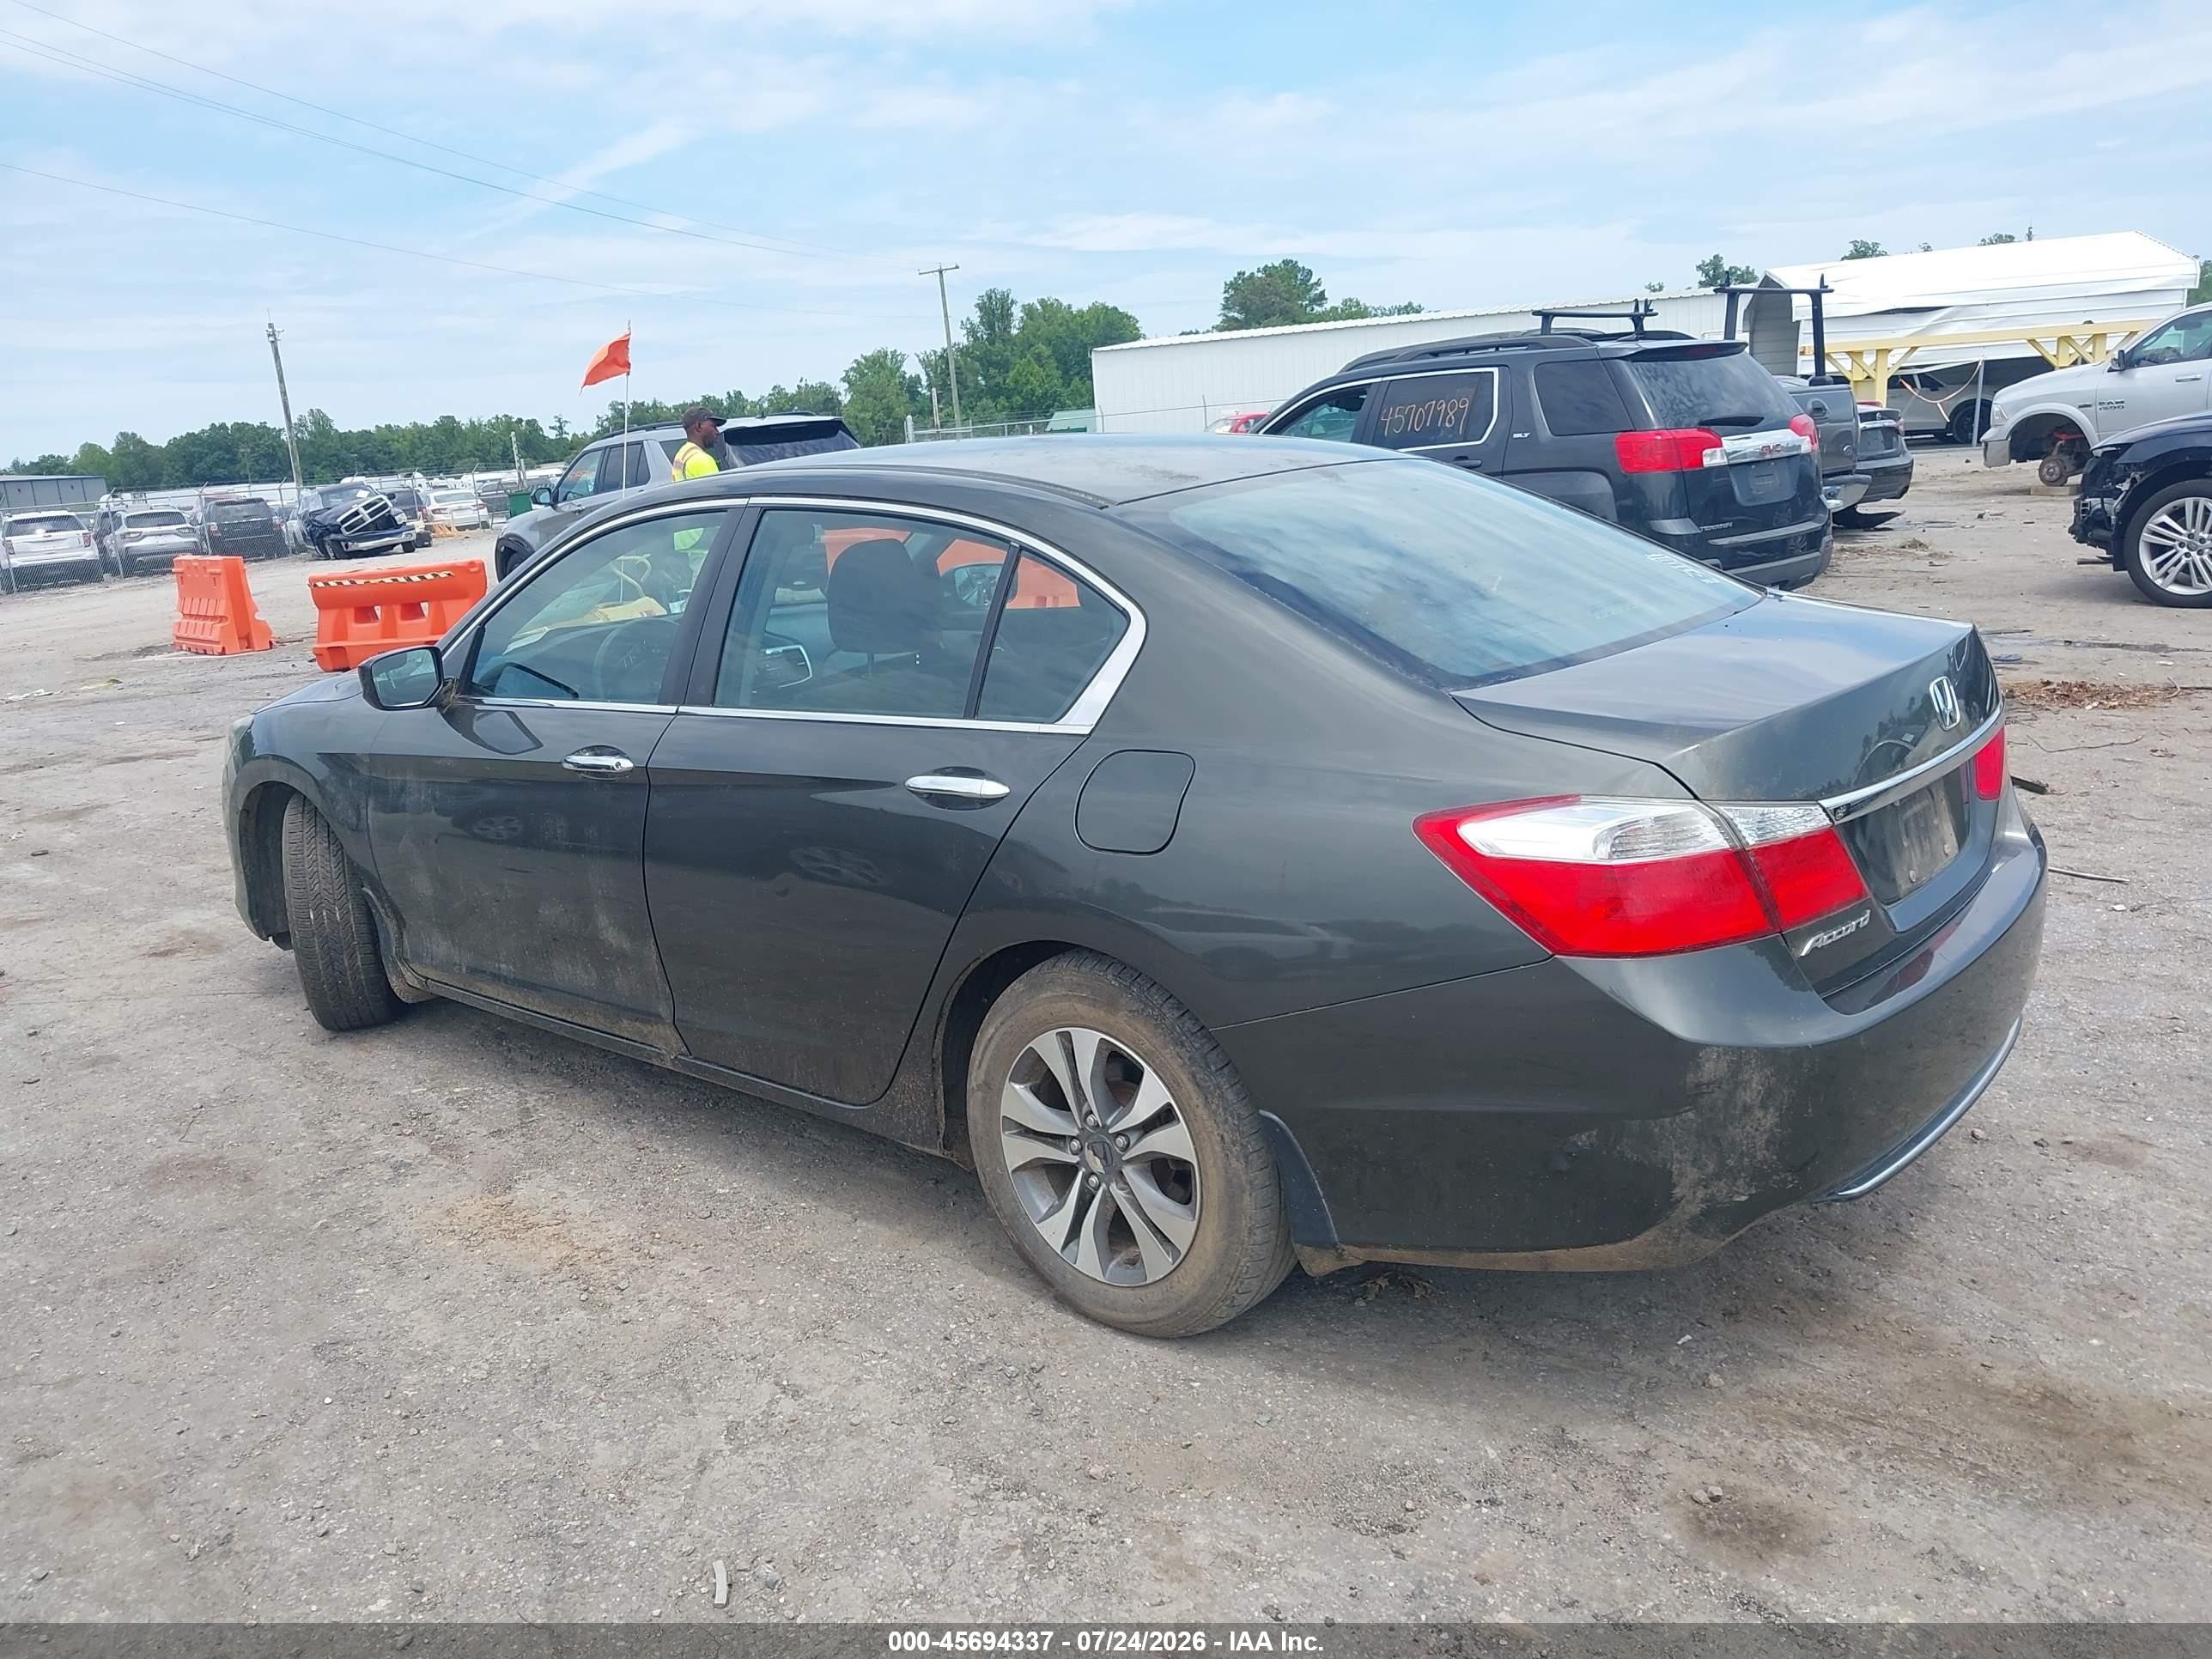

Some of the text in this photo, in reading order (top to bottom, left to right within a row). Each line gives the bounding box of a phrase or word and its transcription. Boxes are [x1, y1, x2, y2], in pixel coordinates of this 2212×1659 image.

[1381, 398, 1470, 437] 45707989
[1759, 443, 1783, 454] GMC
[1800, 909, 1871, 956] Accord
